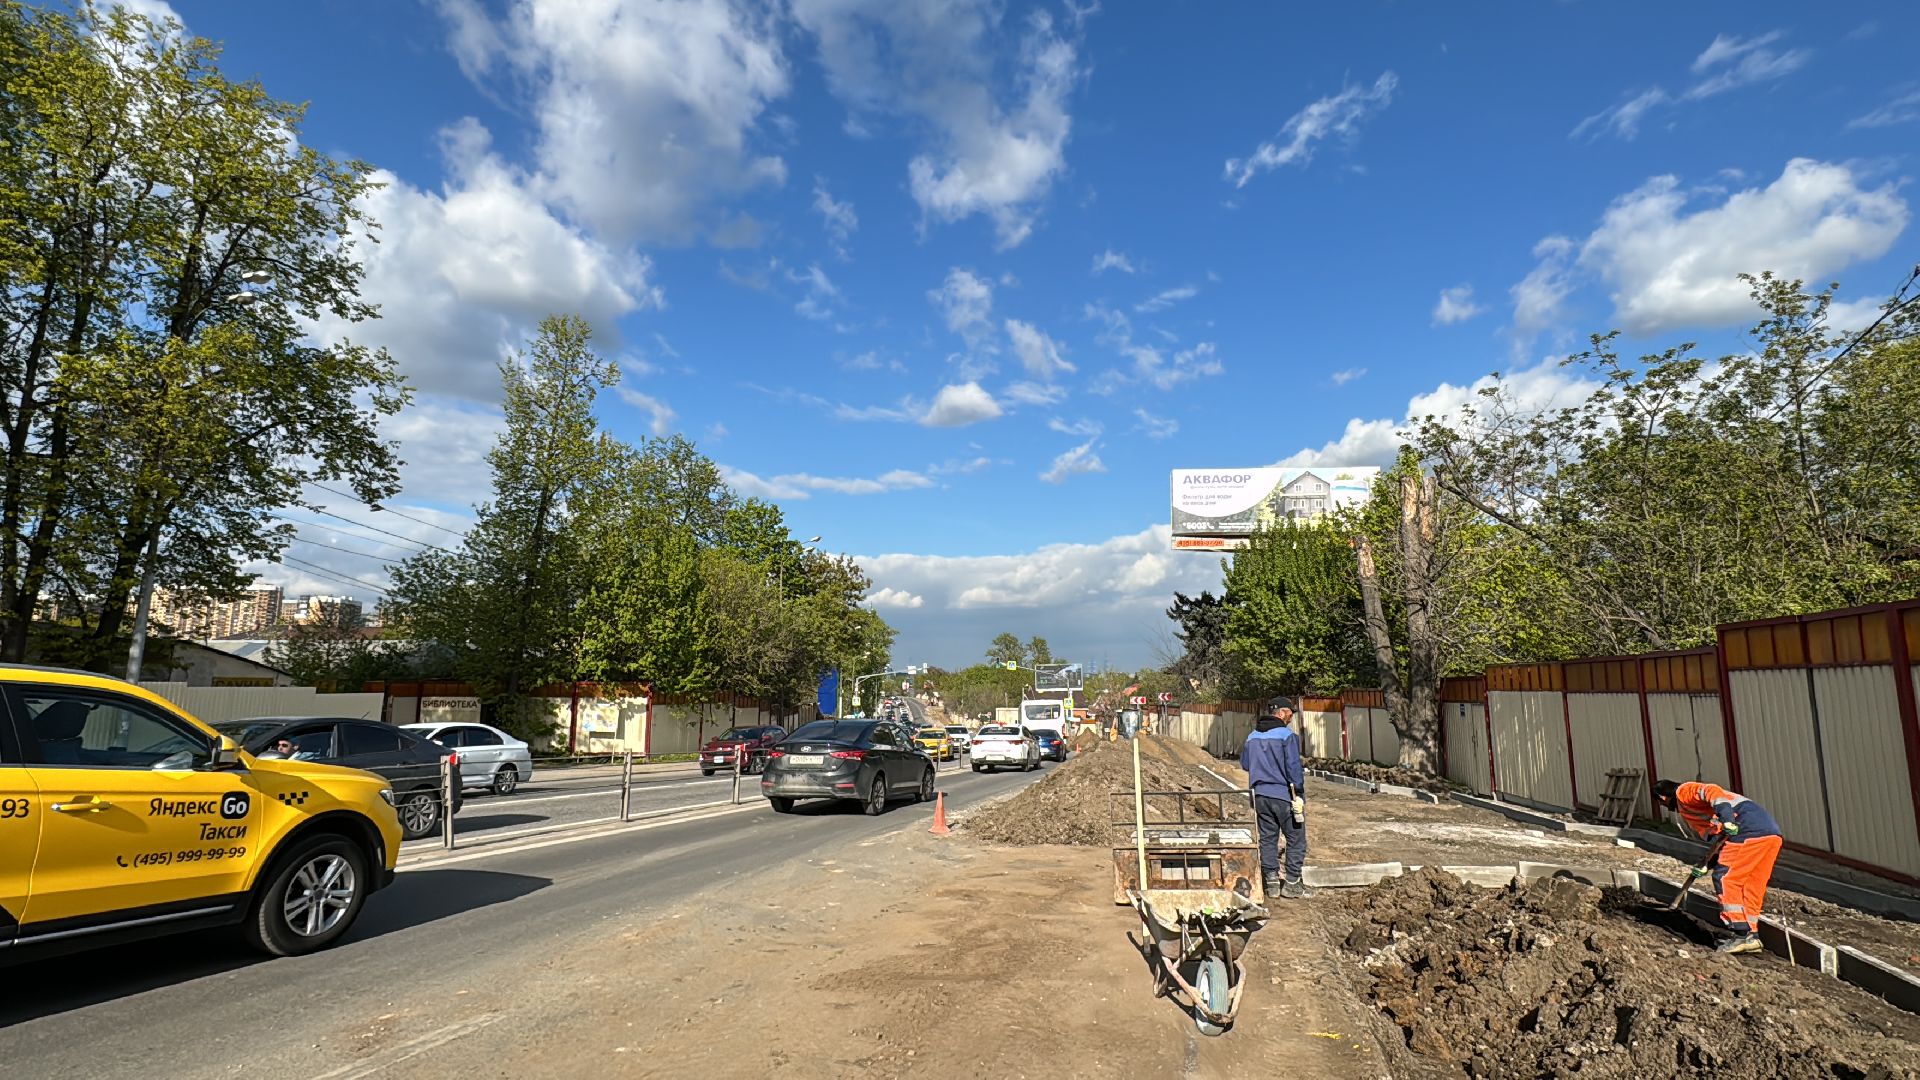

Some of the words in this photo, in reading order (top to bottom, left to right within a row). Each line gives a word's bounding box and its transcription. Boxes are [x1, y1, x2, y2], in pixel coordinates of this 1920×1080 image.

[1183, 474, 1252, 485] АКВАФОР
[422, 700, 478, 709] БИБЛИОТЕКА
[1, 799, 29, 818] 93
[148, 798, 217, 817] Яндекс
[223, 797, 247, 815] Go
[199, 822, 247, 841] Такси
[133, 852, 173, 868] (495)
[176, 846, 247, 863] 999-99-99
